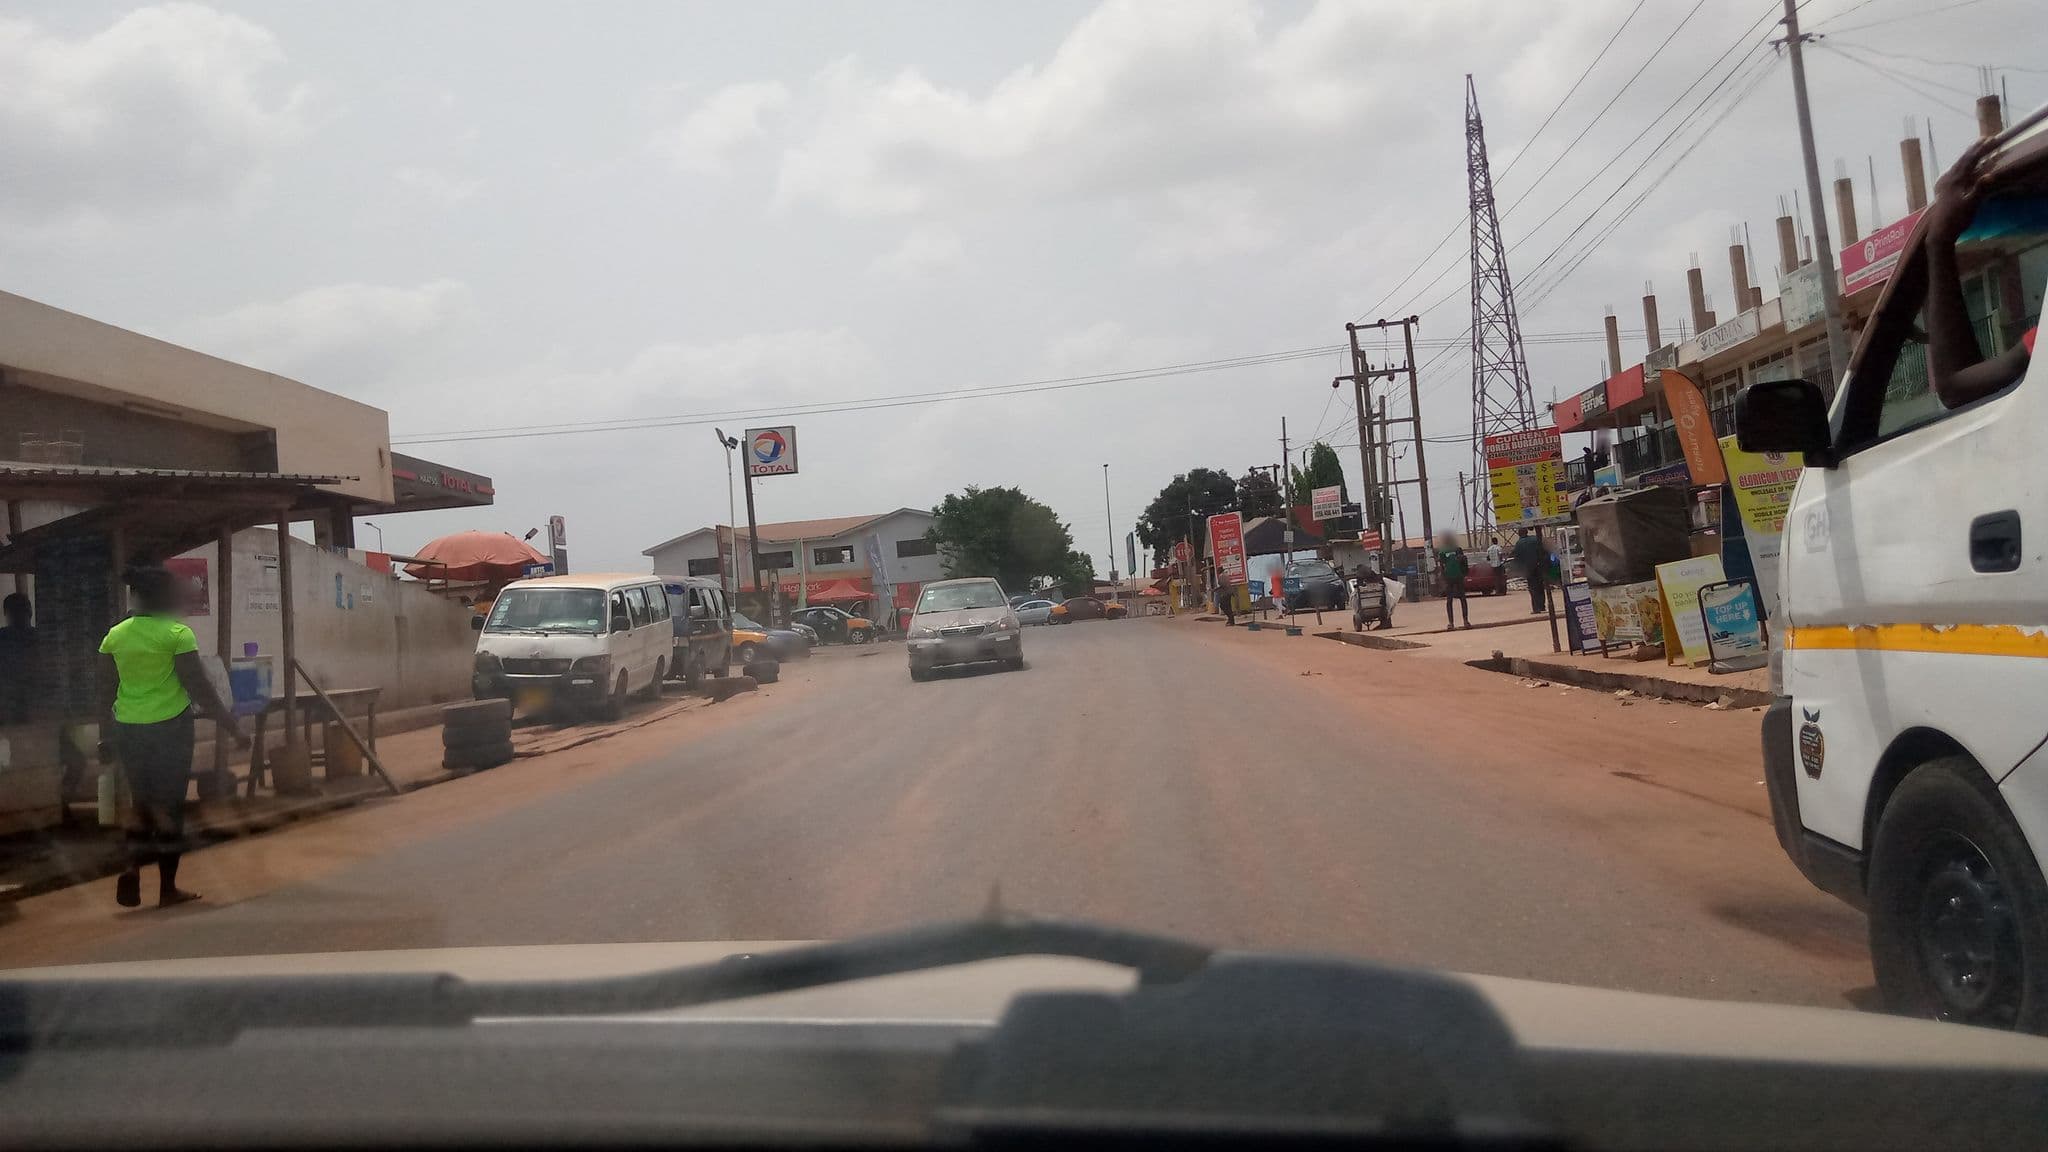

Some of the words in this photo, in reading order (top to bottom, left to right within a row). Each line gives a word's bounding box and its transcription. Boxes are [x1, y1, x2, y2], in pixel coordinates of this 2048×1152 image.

[1486, 442, 1511, 453] FOREX
[1512, 438, 1544, 450] BUREAU
[1545, 435, 1560, 444] LTD
[1496, 432, 1548, 443] CURRENT
[751, 464, 793, 474] TOTAL
[441, 471, 473, 495] TOTAL
[1738, 471, 1779, 488] GLORICOM
[1715, 605, 1732, 615] TOP
[1735, 601, 1748, 611] UP
[1716, 612, 1742, 624] HERE
